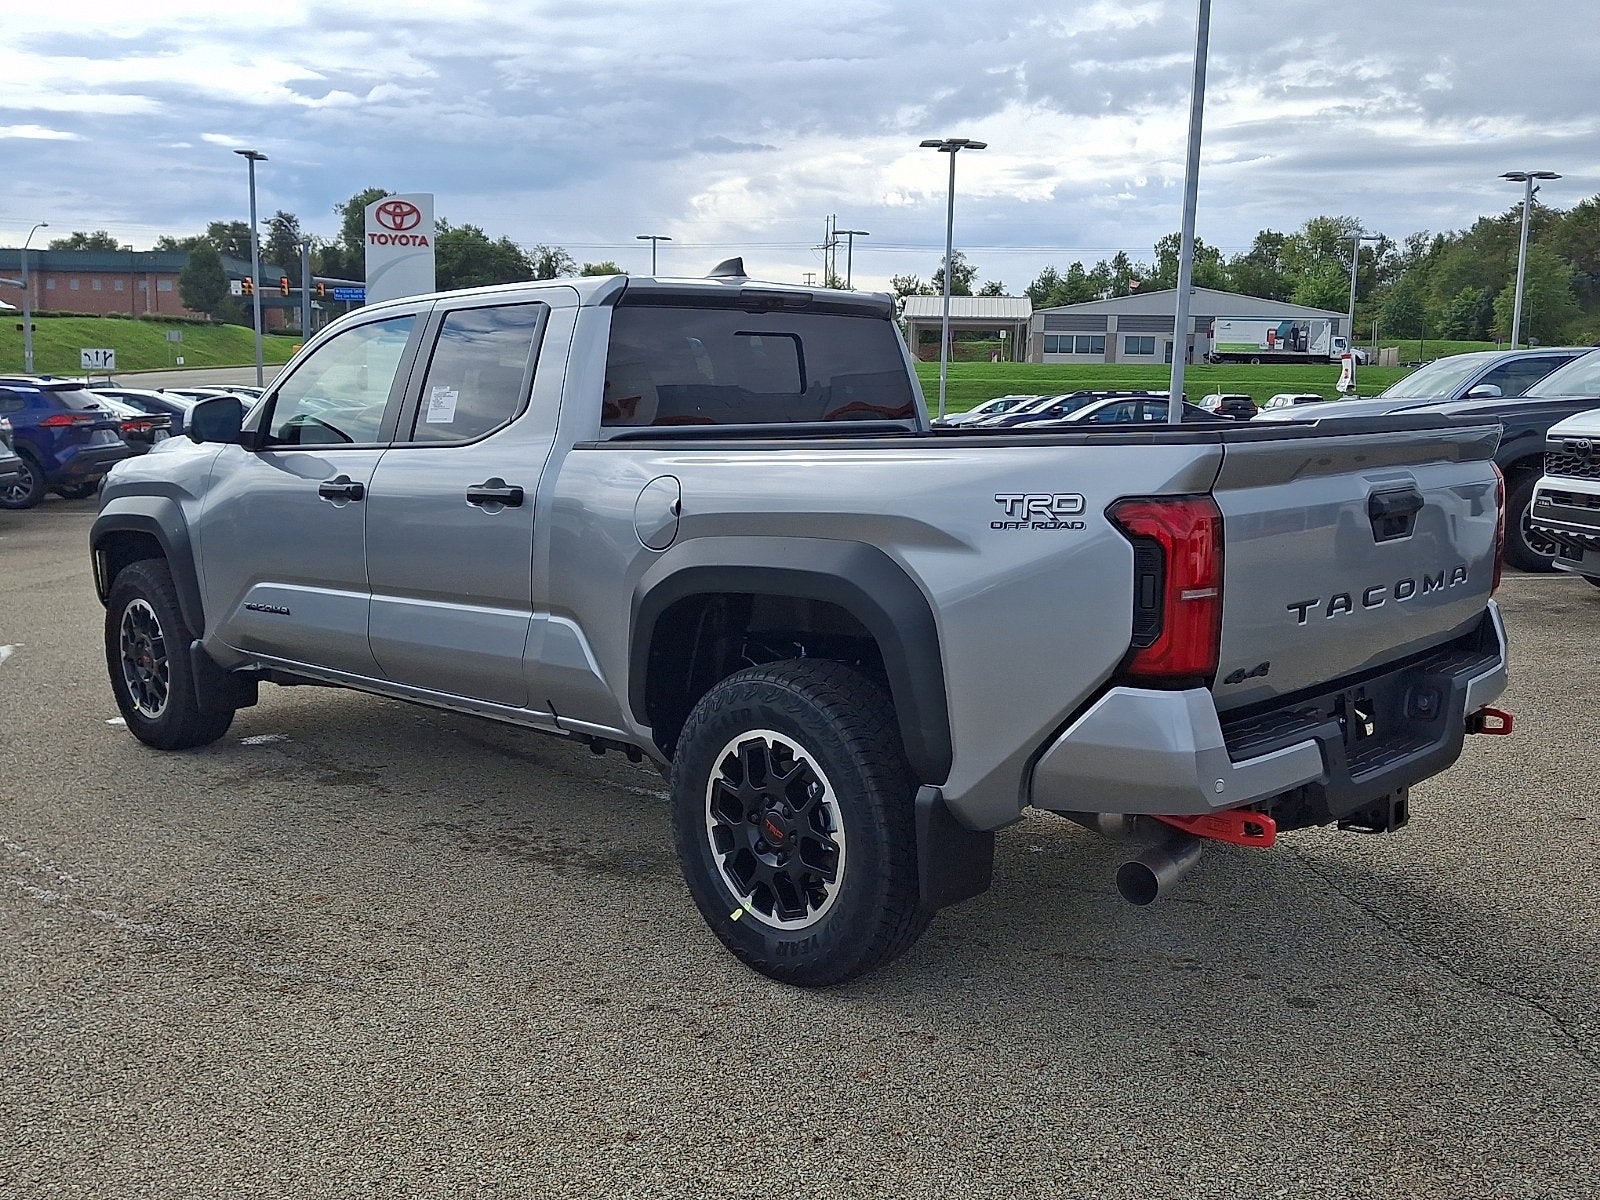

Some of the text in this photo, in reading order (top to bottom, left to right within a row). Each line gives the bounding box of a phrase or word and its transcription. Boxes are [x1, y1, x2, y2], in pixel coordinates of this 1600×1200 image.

[368, 233, 429, 247] TOYOTA
[994, 493, 1086, 521] TRD
[990, 521, 1086, 531] OFF ROAD
[1286, 564, 1468, 627] TACOMA
